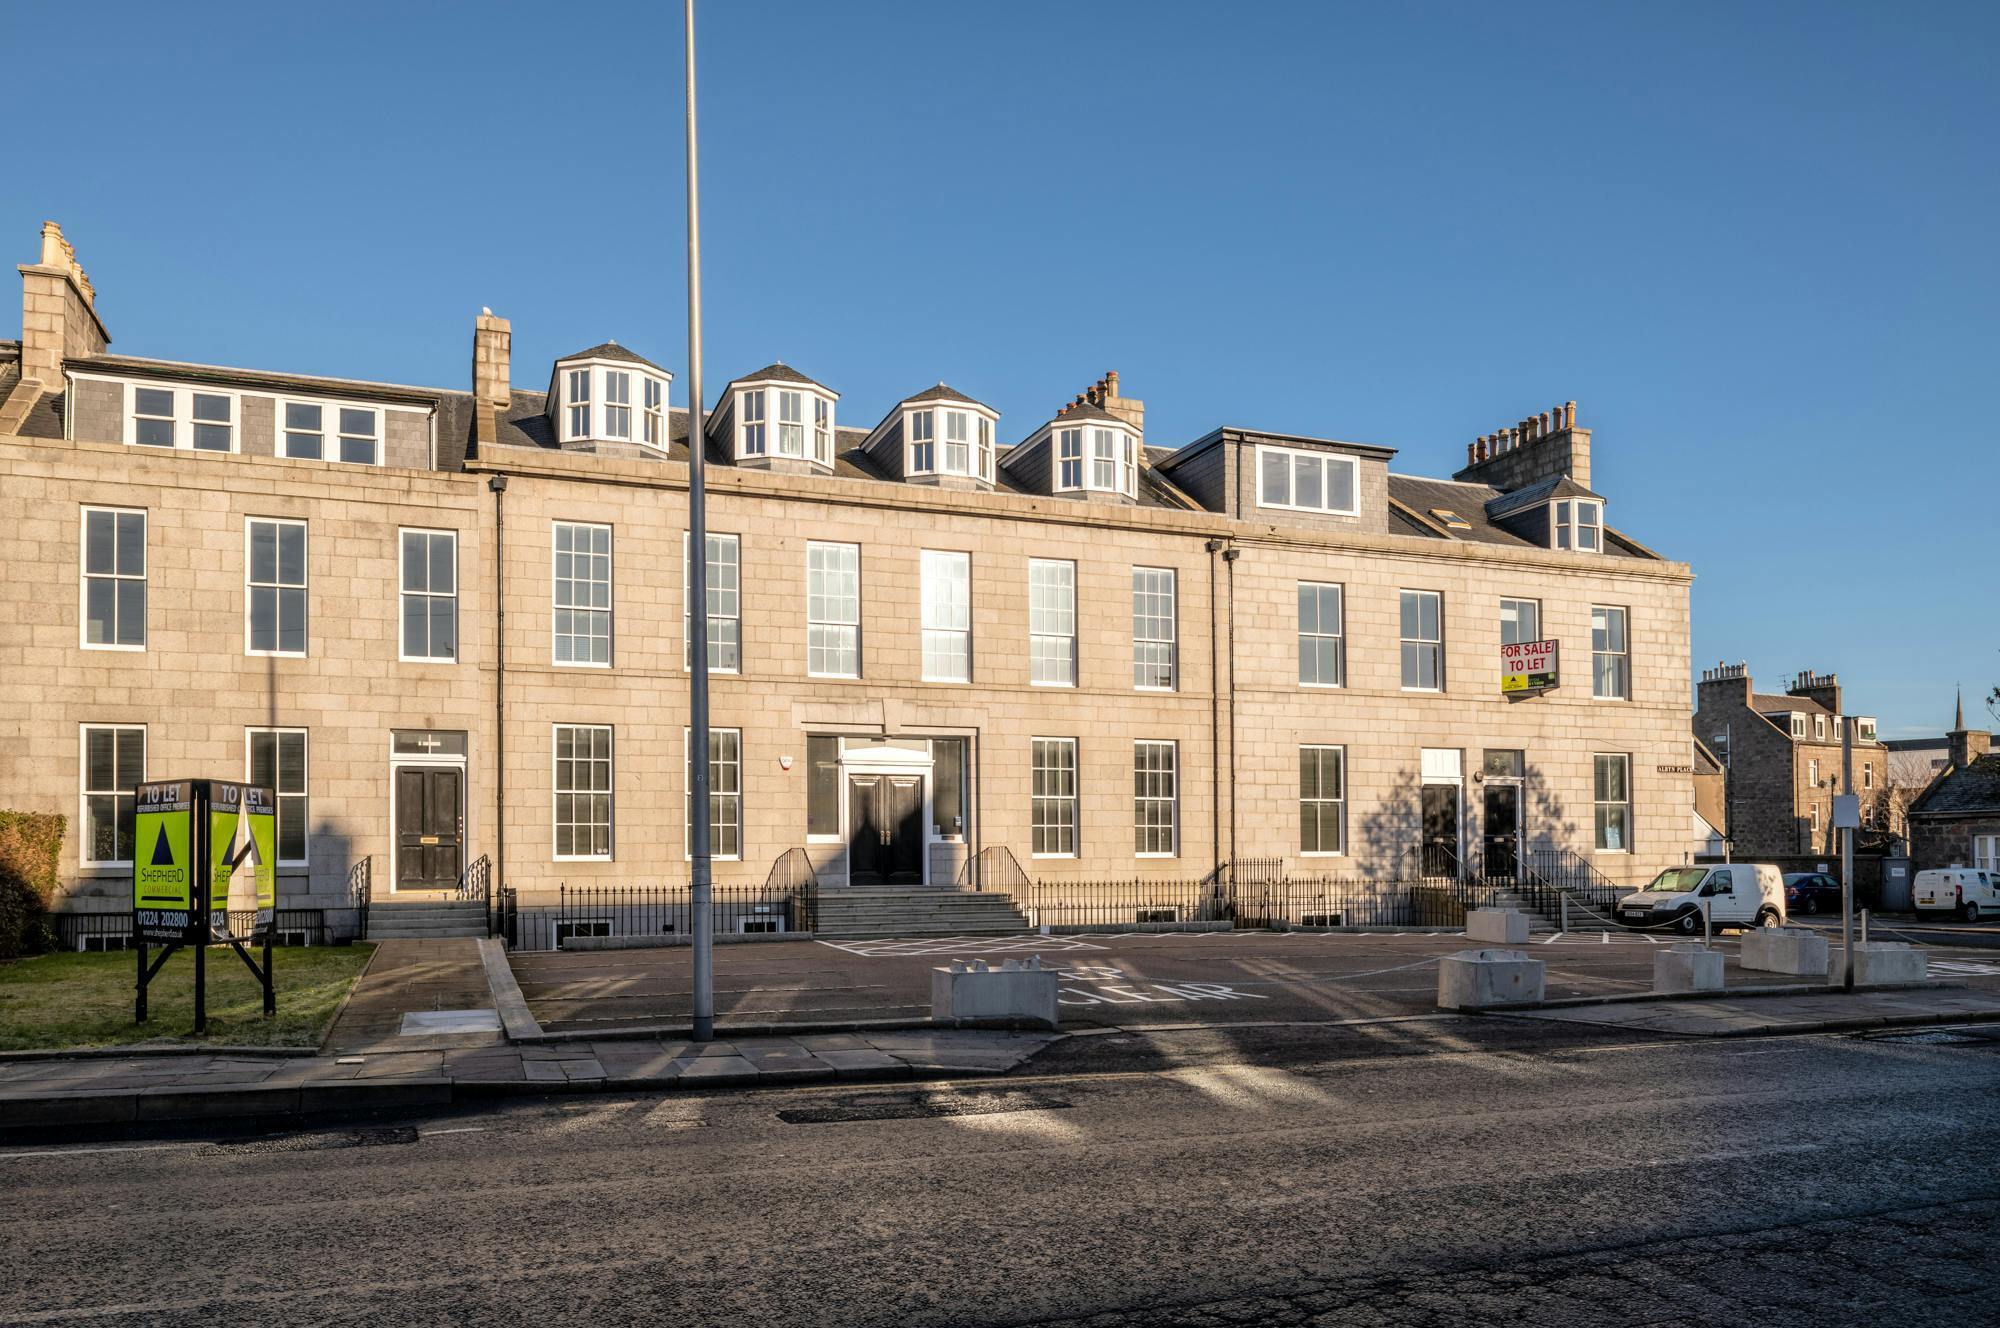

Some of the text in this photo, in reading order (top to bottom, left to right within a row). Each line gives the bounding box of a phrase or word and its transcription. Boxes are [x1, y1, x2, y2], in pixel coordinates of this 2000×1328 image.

[1501, 646, 1521, 658] FOR
[1509, 657, 1546, 672] TO LET
[146, 784, 181, 803] TO LET
[221, 784, 263, 805] TO LET
[141, 867, 184, 883] SHEPHERD
[143, 885, 182, 894] COMMERCIAL
[137, 910, 188, 928] 01224 202800
